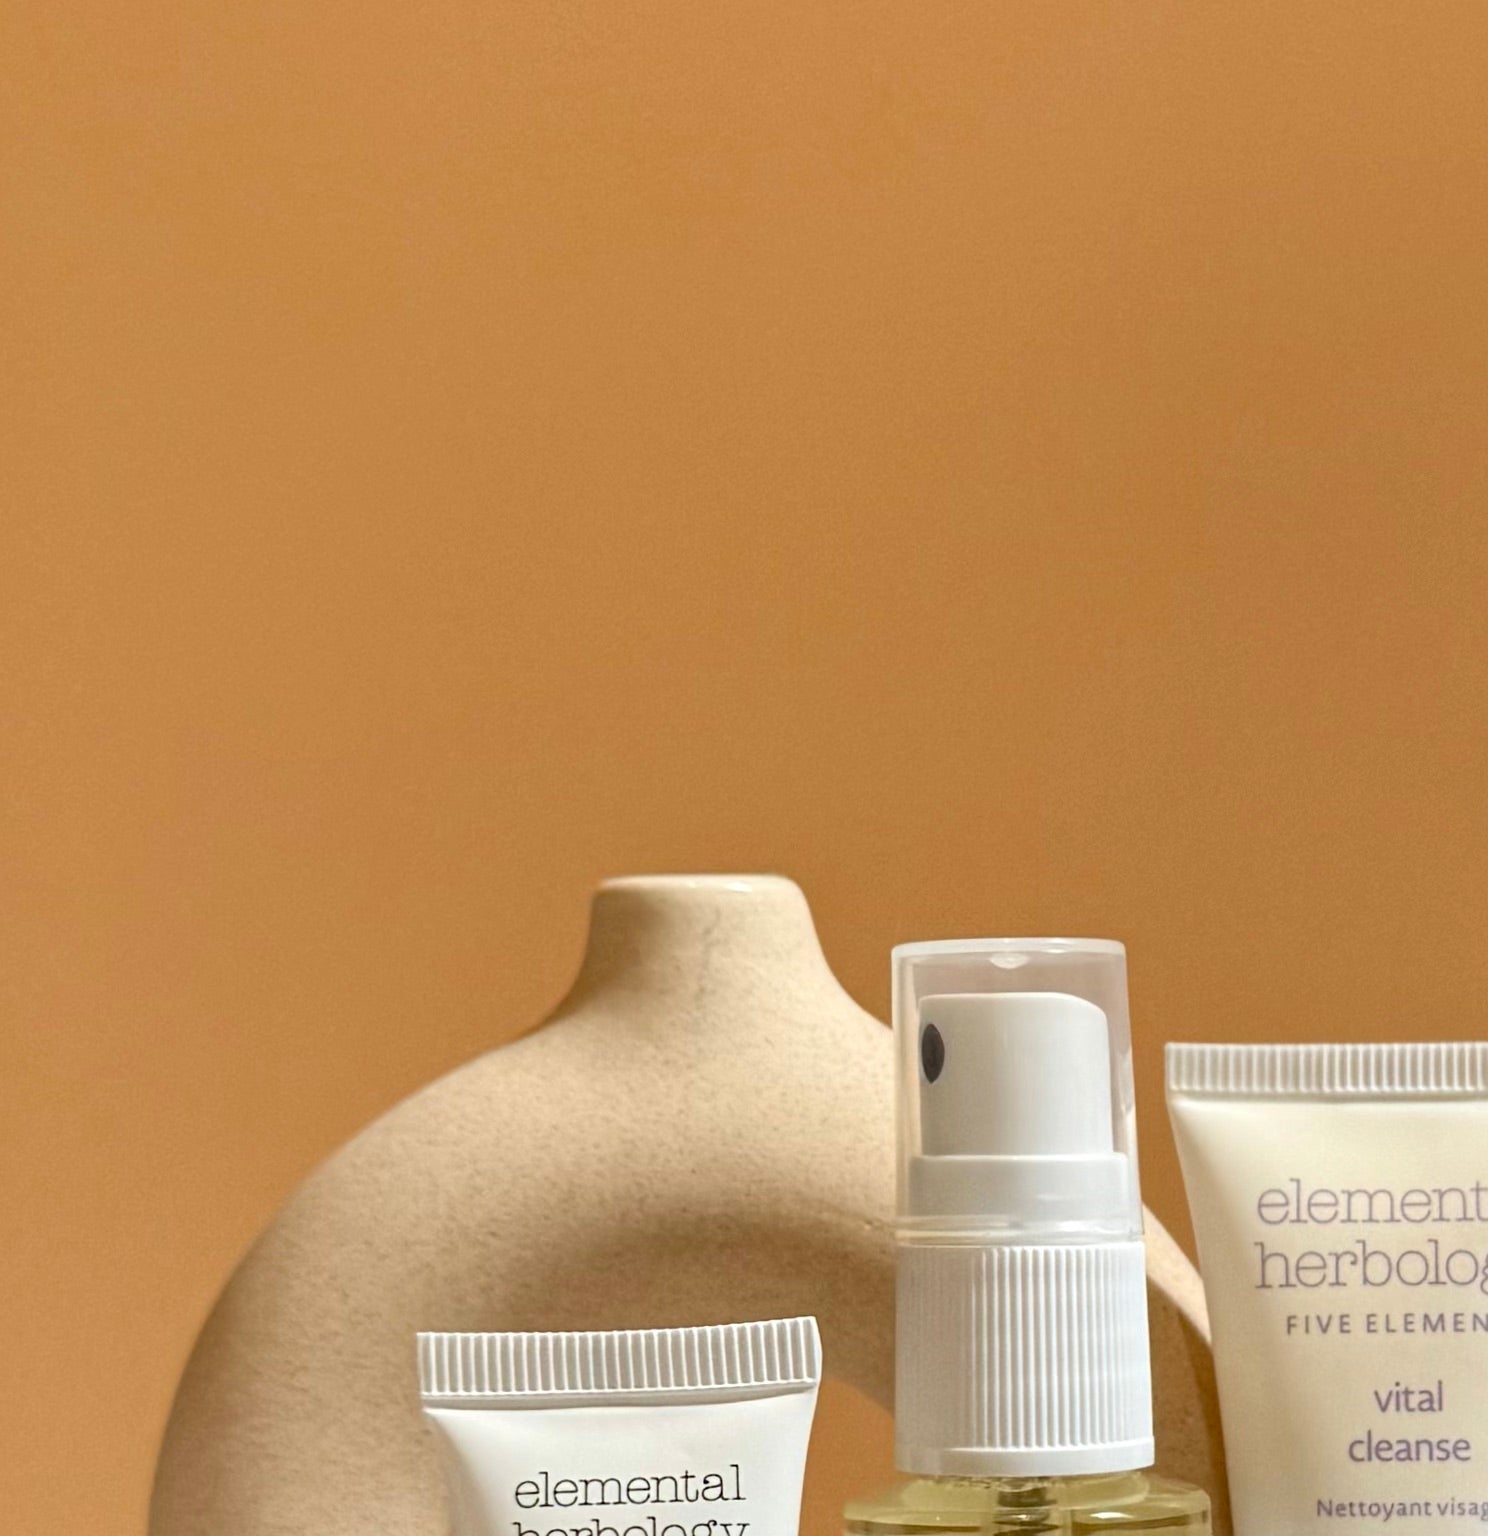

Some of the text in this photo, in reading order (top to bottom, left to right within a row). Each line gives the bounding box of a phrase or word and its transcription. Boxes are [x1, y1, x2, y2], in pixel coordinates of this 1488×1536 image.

[1287, 1314, 1351, 1335] FIVE
[1374, 1380, 1443, 1413] vital
[1349, 1429, 1471, 1462] cleanse
[515, 1464, 746, 1508] elemental
[1317, 1499, 1432, 1522] Nettoyant
